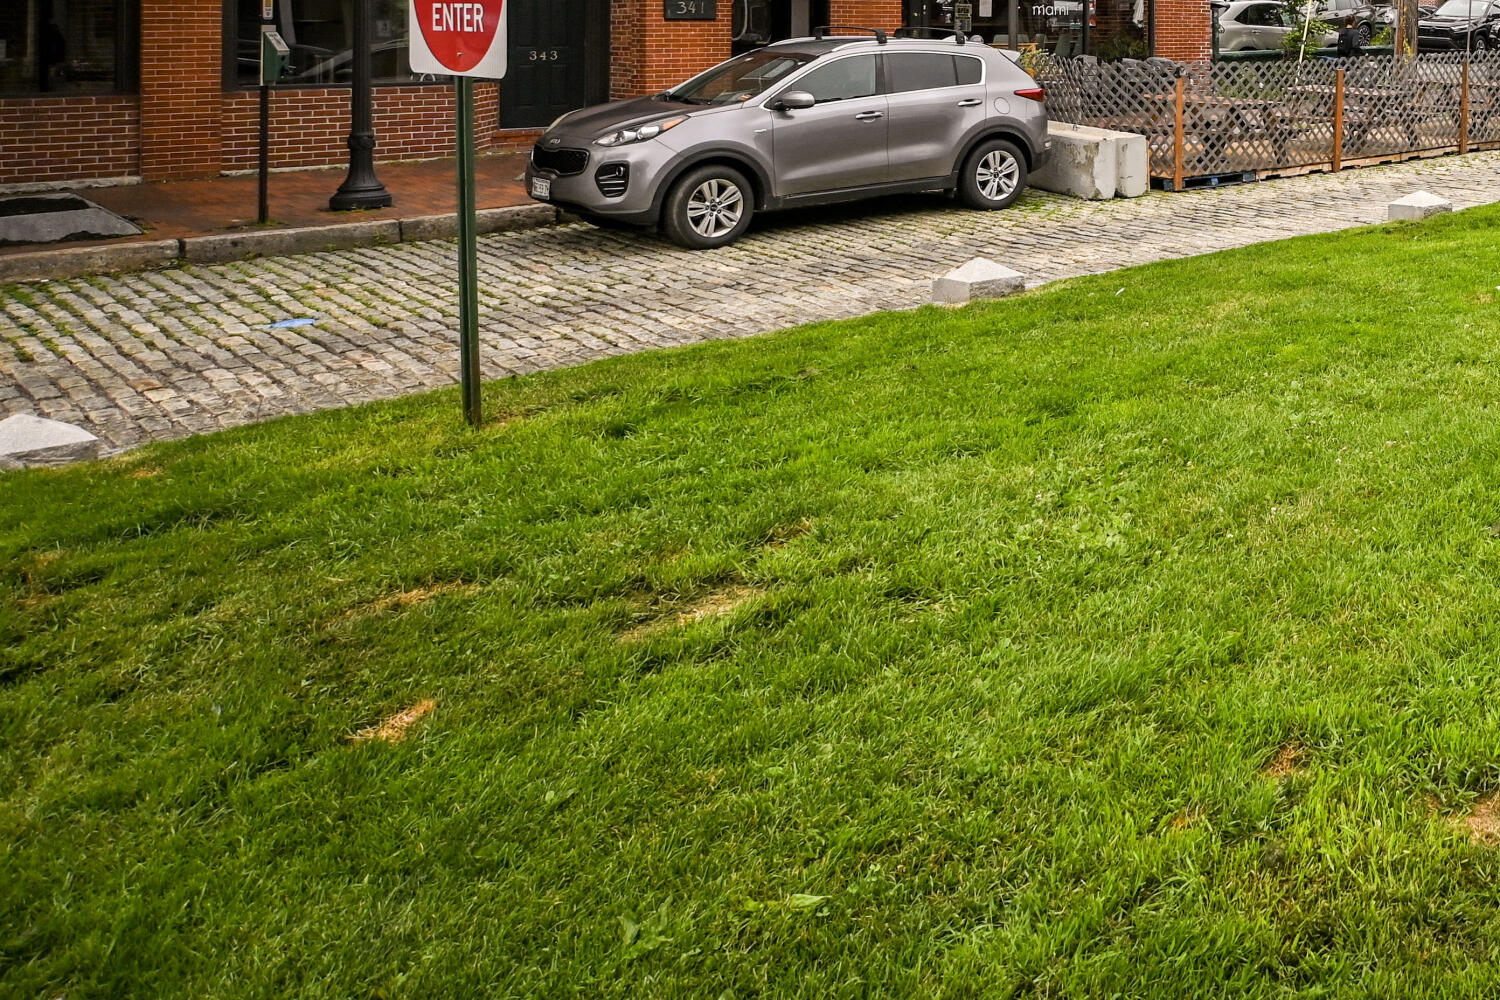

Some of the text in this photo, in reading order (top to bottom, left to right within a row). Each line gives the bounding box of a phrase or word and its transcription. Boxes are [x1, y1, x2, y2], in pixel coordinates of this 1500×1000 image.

[676, 1, 705, 14] 341
[1032, 4, 1069, 16] mami
[432, 3, 484, 33] ENTER
[529, 50, 559, 61] 343
